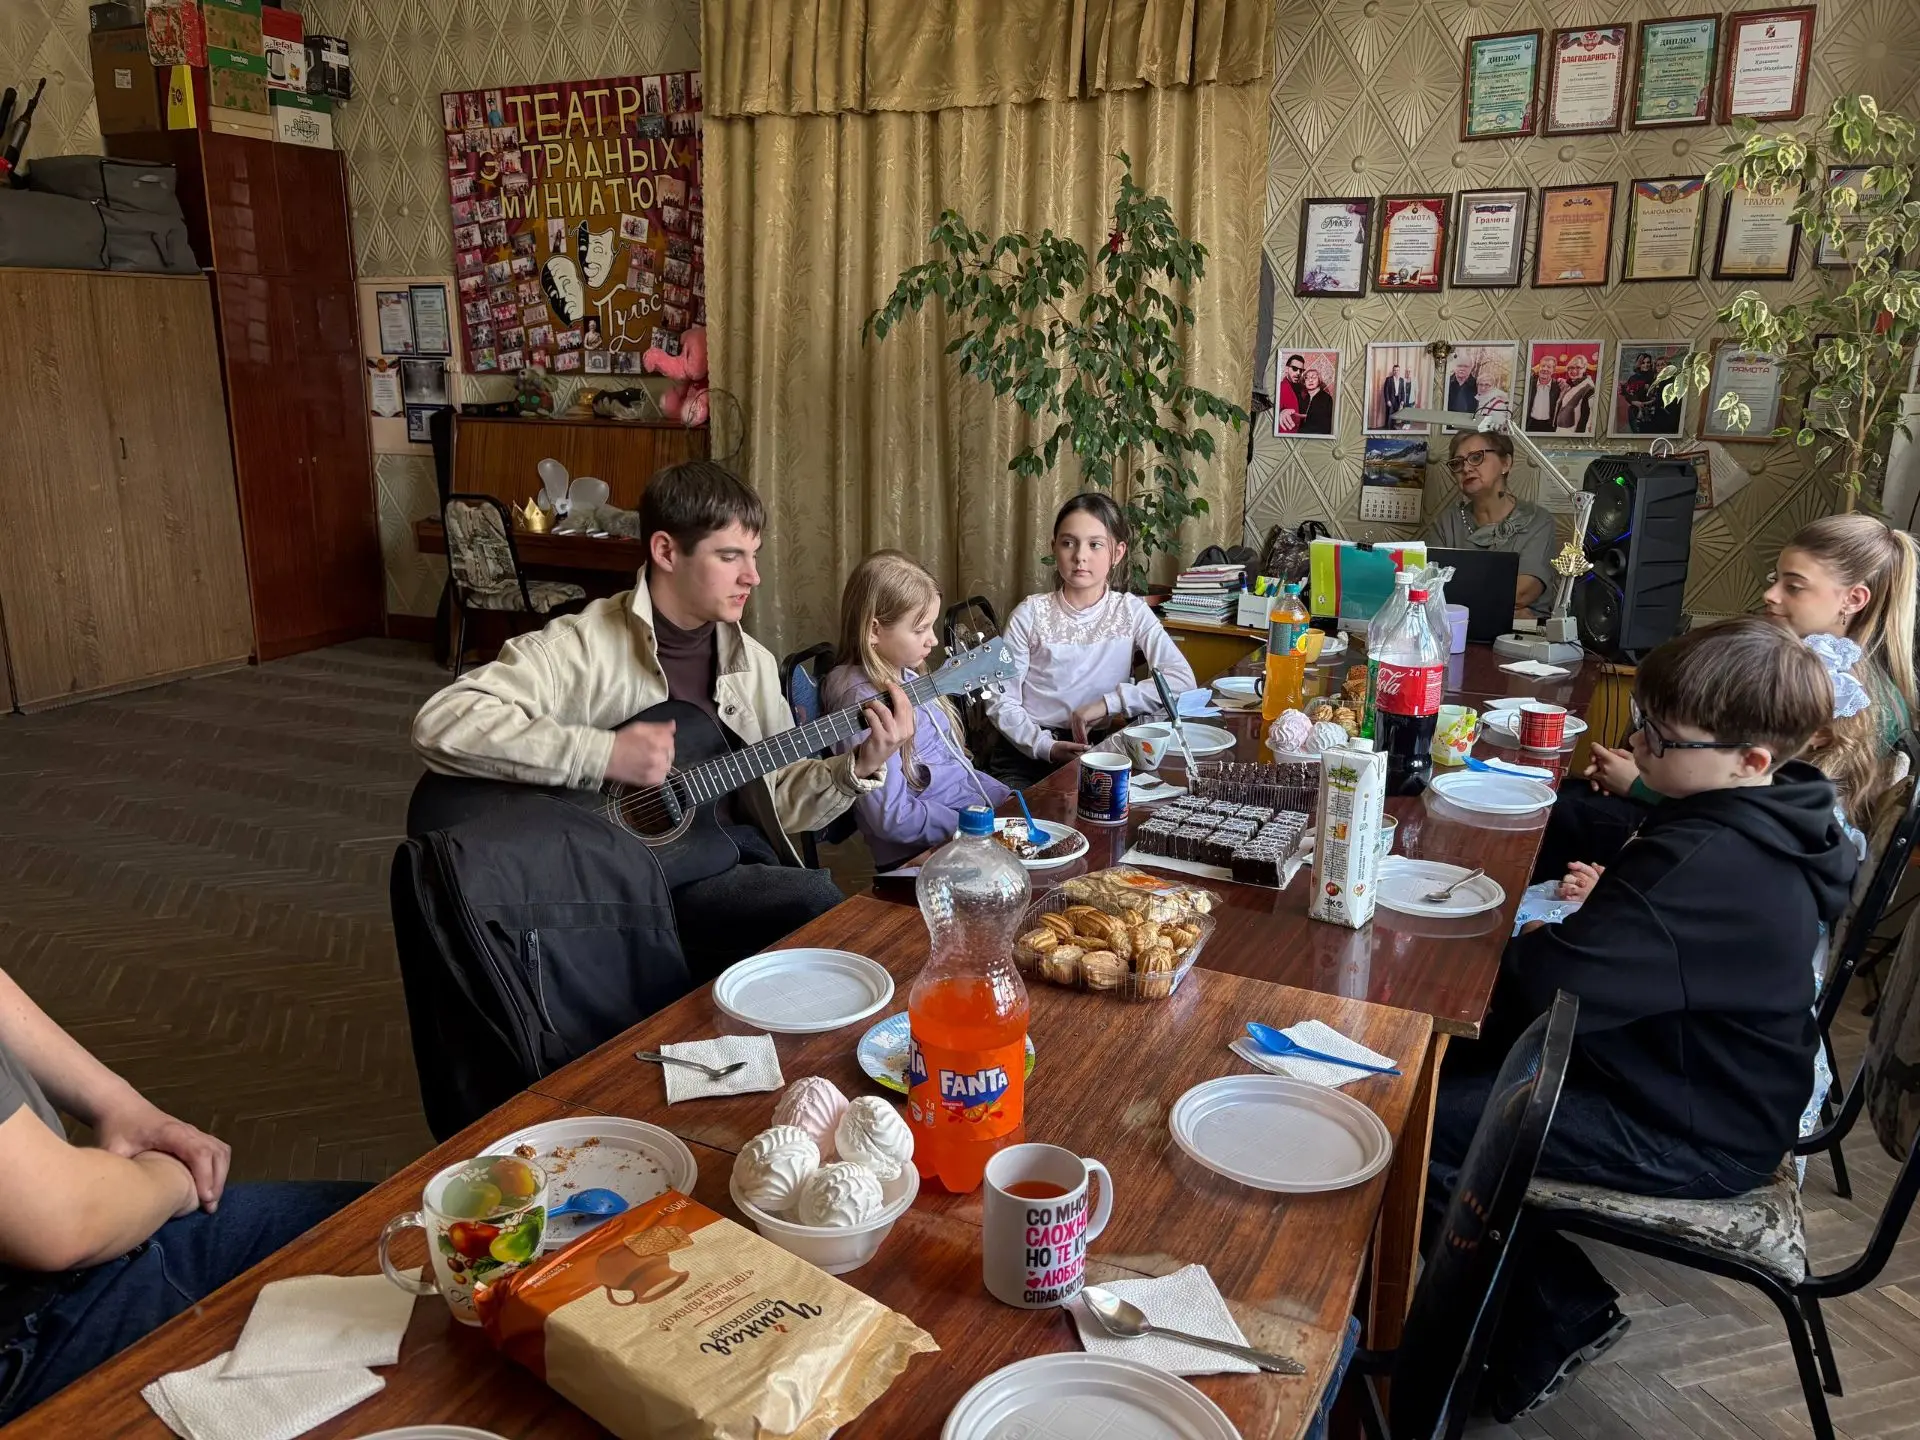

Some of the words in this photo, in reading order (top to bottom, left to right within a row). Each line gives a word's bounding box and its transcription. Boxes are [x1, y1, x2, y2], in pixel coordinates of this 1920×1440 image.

[272, 39, 293, 50] Tefal
[1487, 54, 1521, 64] ДИПЛОМ
[1562, 52, 1616, 63] БЛАГОДАРНОСТЬ
[506, 86, 641, 144] ТЕАТР
[479, 137, 679, 181] ЭТРАДНЫХ
[1744, 197, 1785, 206] ГРАМОТА
[1476, 216, 1510, 225] Грамота
[1727, 366, 1770, 374] ГРАМОТА
[940, 1067, 1009, 1097] FANTA
[1026, 1208, 1052, 1226] СО
[1025, 1248, 1052, 1267] НО
[1055, 1243, 1072, 1265] ТЕ
[1041, 1258, 1081, 1287] ЛЮБЯТ
[700, 1299, 823, 1356] Чайная
[707, 1298, 775, 1340] КОЛЛЕКЦИЯ
